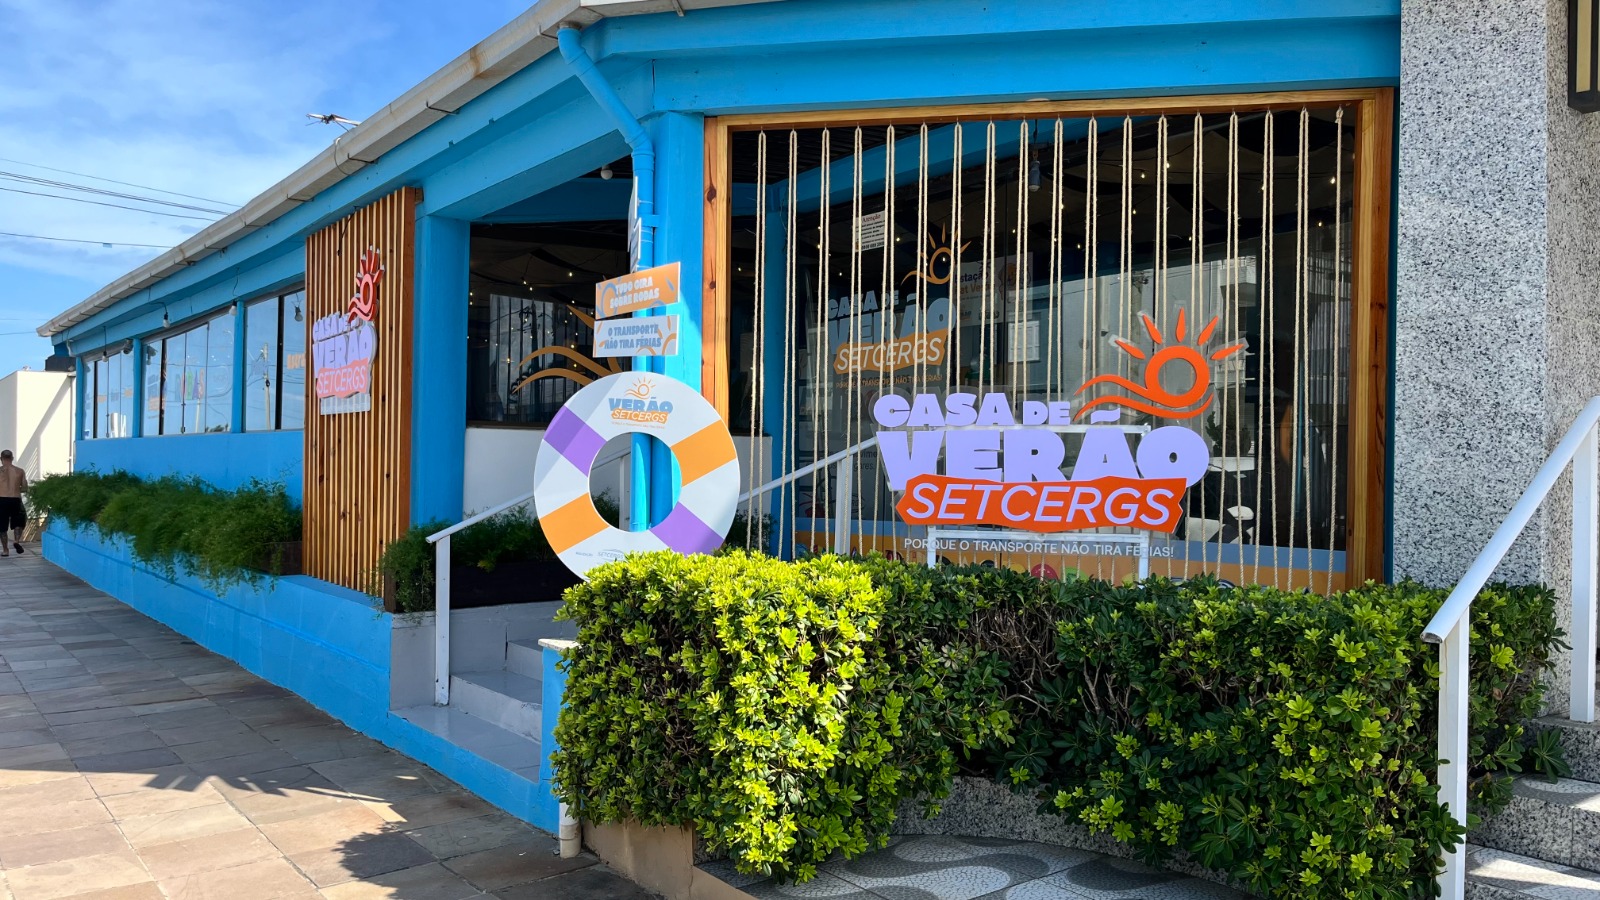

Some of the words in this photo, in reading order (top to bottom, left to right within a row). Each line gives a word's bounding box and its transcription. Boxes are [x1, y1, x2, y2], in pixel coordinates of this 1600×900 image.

[610, 294, 633, 309] SOBRE
[633, 288, 660, 304] RODAS
[616, 281, 633, 294] TUDO
[634, 276, 653, 290] GIRA
[827, 290, 878, 319] CASA
[608, 327, 613, 337] O
[613, 324, 659, 337] TRANSPORTE
[827, 292, 957, 355] VERÃO
[312, 316, 375, 379] VERÃO
[604, 337, 618, 350] NÃO
[620, 339, 634, 349] TIRA
[636, 335, 662, 348] FÉRIAS
[837, 337, 942, 371] SETCERGS
[317, 365, 367, 394] SETCERGS
[608, 396, 674, 415] VERÃO
[613, 409, 667, 423] SETCERGS
[873, 392, 1015, 427] CASA
[1023, 401, 1071, 426] DE
[876, 407, 1210, 491] VERÃO
[906, 482, 1175, 525] SETCERGS
[904, 537, 957, 551] PORQUE
[960, 539, 970, 551] O
[973, 539, 1058, 553] TRANSPORTE
[1061, 541, 1090, 555] NÃO
[1093, 543, 1123, 556] TIRA
